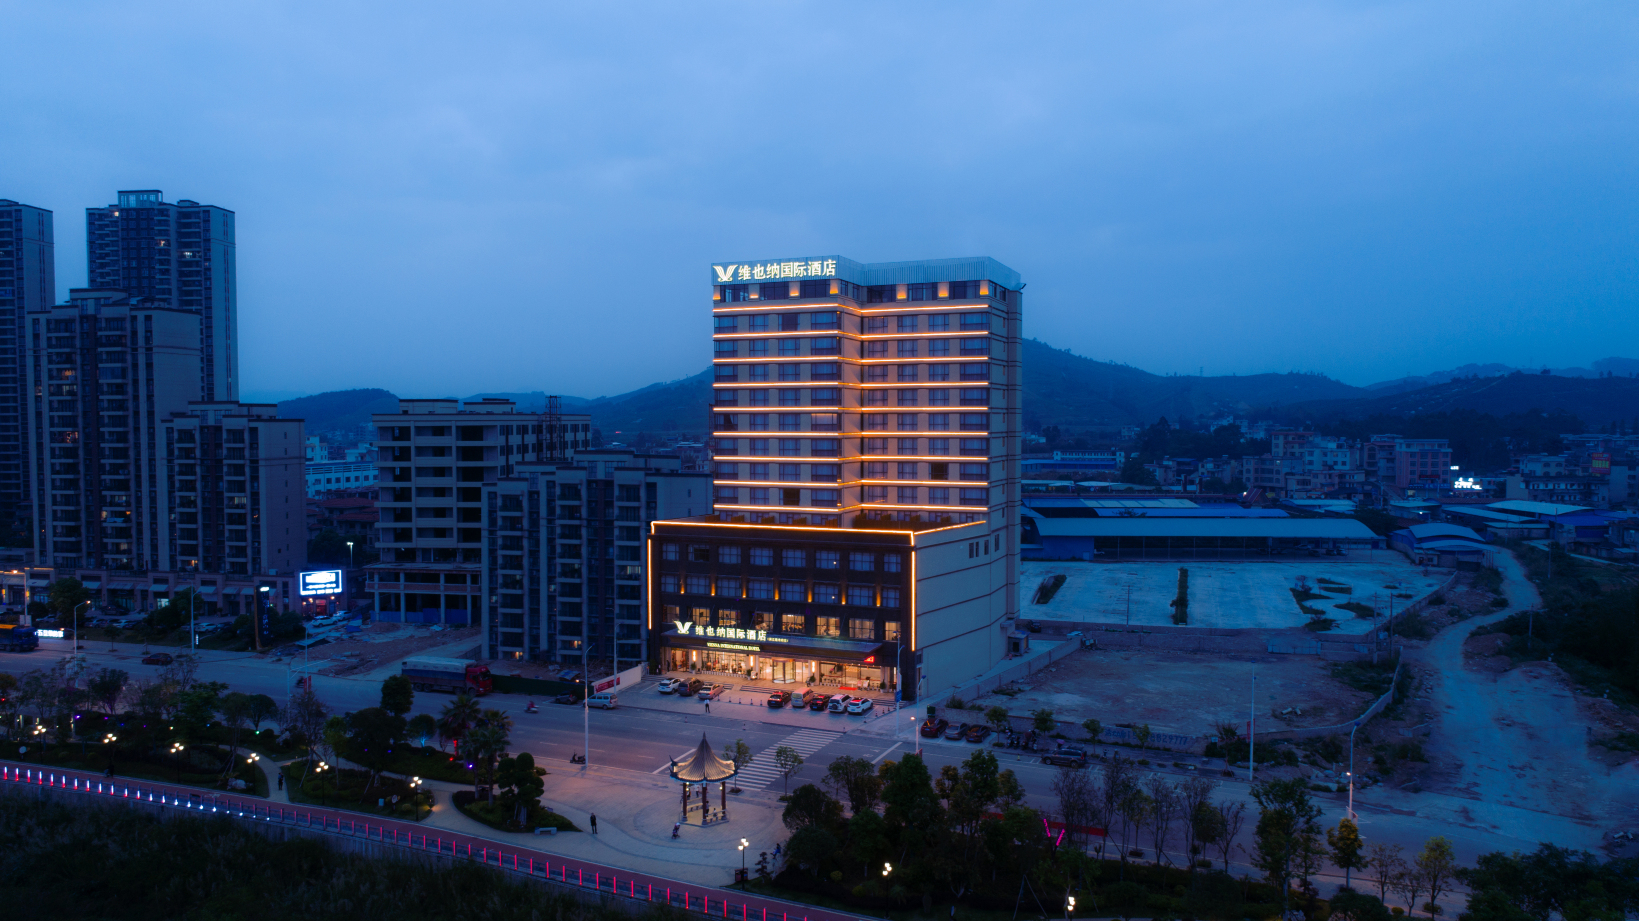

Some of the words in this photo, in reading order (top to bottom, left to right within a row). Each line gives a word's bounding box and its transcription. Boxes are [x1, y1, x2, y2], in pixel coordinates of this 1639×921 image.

[738, 259, 837, 281] 维也纳国际酒店
[695, 625, 767, 641] 维也纳国际酒店
[1127, 730, 1188, 745] 158829777
